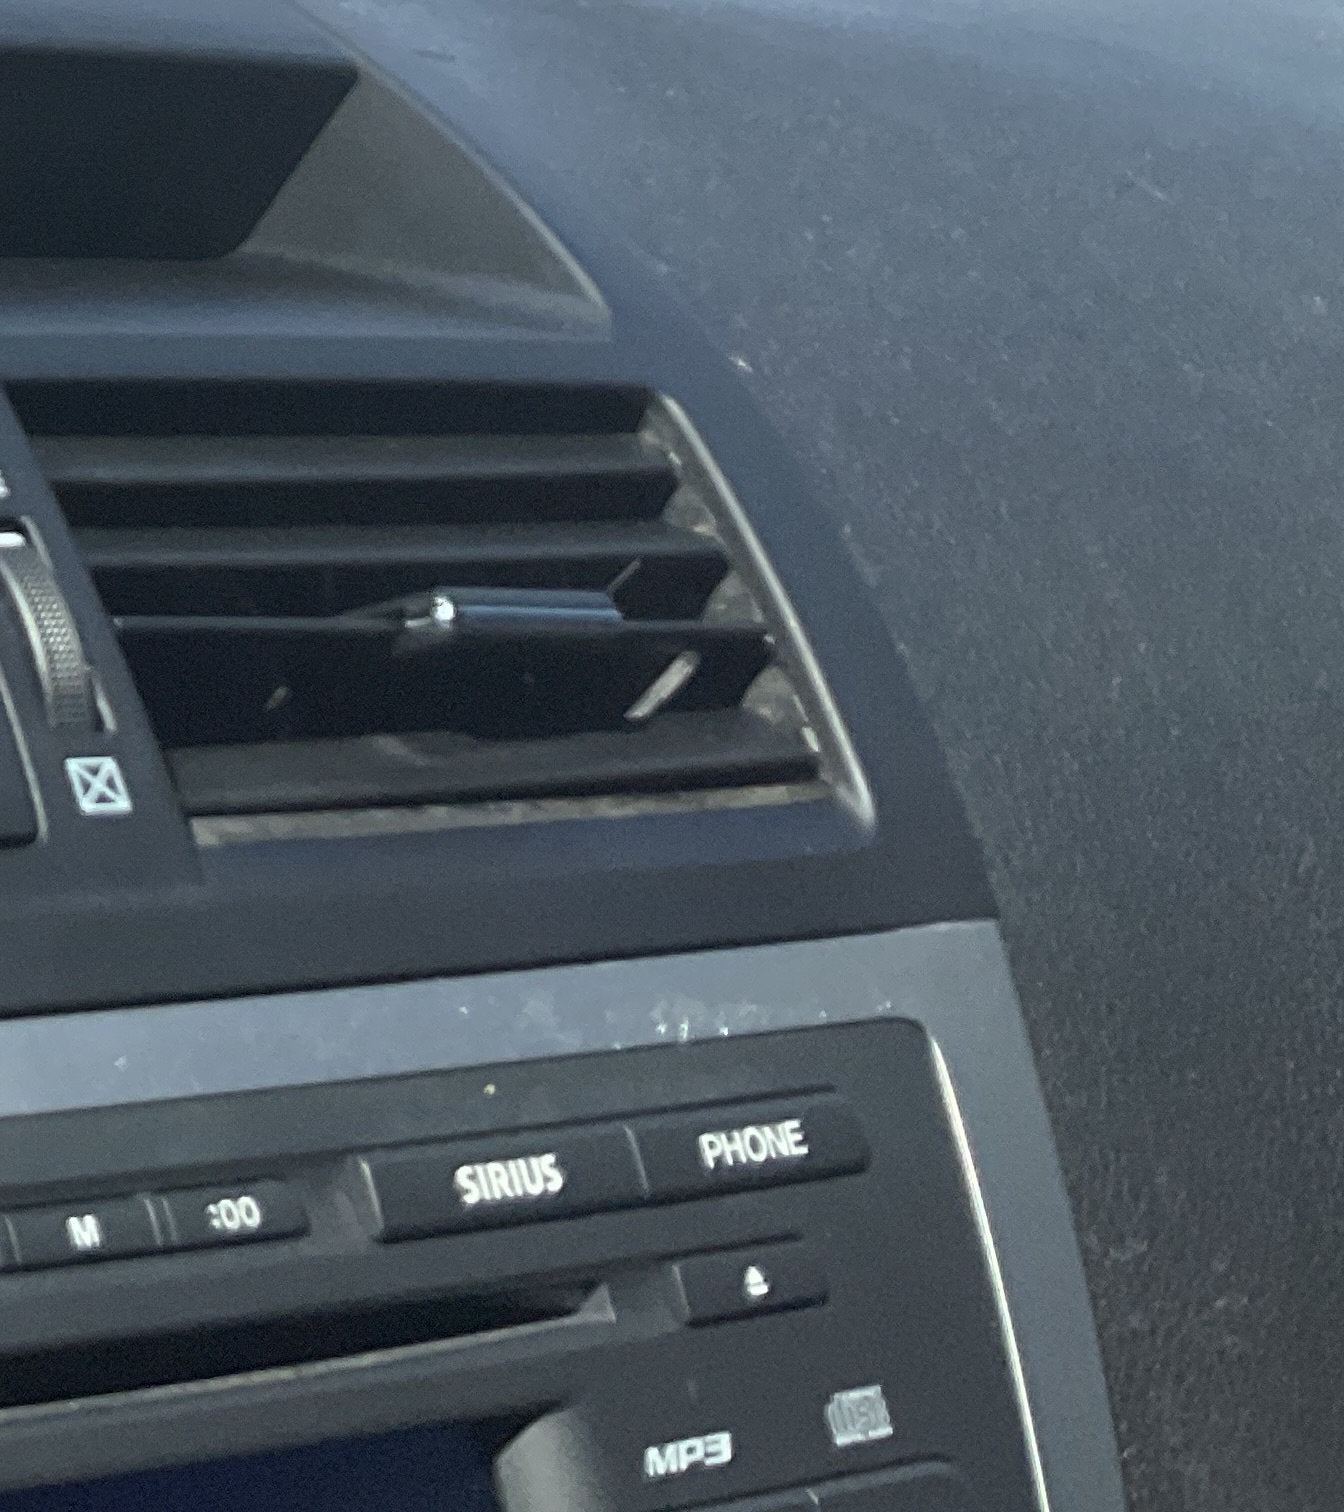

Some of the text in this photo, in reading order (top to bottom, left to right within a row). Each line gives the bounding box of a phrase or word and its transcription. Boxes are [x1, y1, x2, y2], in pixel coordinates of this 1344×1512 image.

[698, 1118, 809, 1170] PHONE
[454, 1152, 564, 1207] SIRIUS
[65, 1214, 102, 1250] M
[206, 1195, 262, 1232] :00
[644, 1431, 732, 1478] MP3
